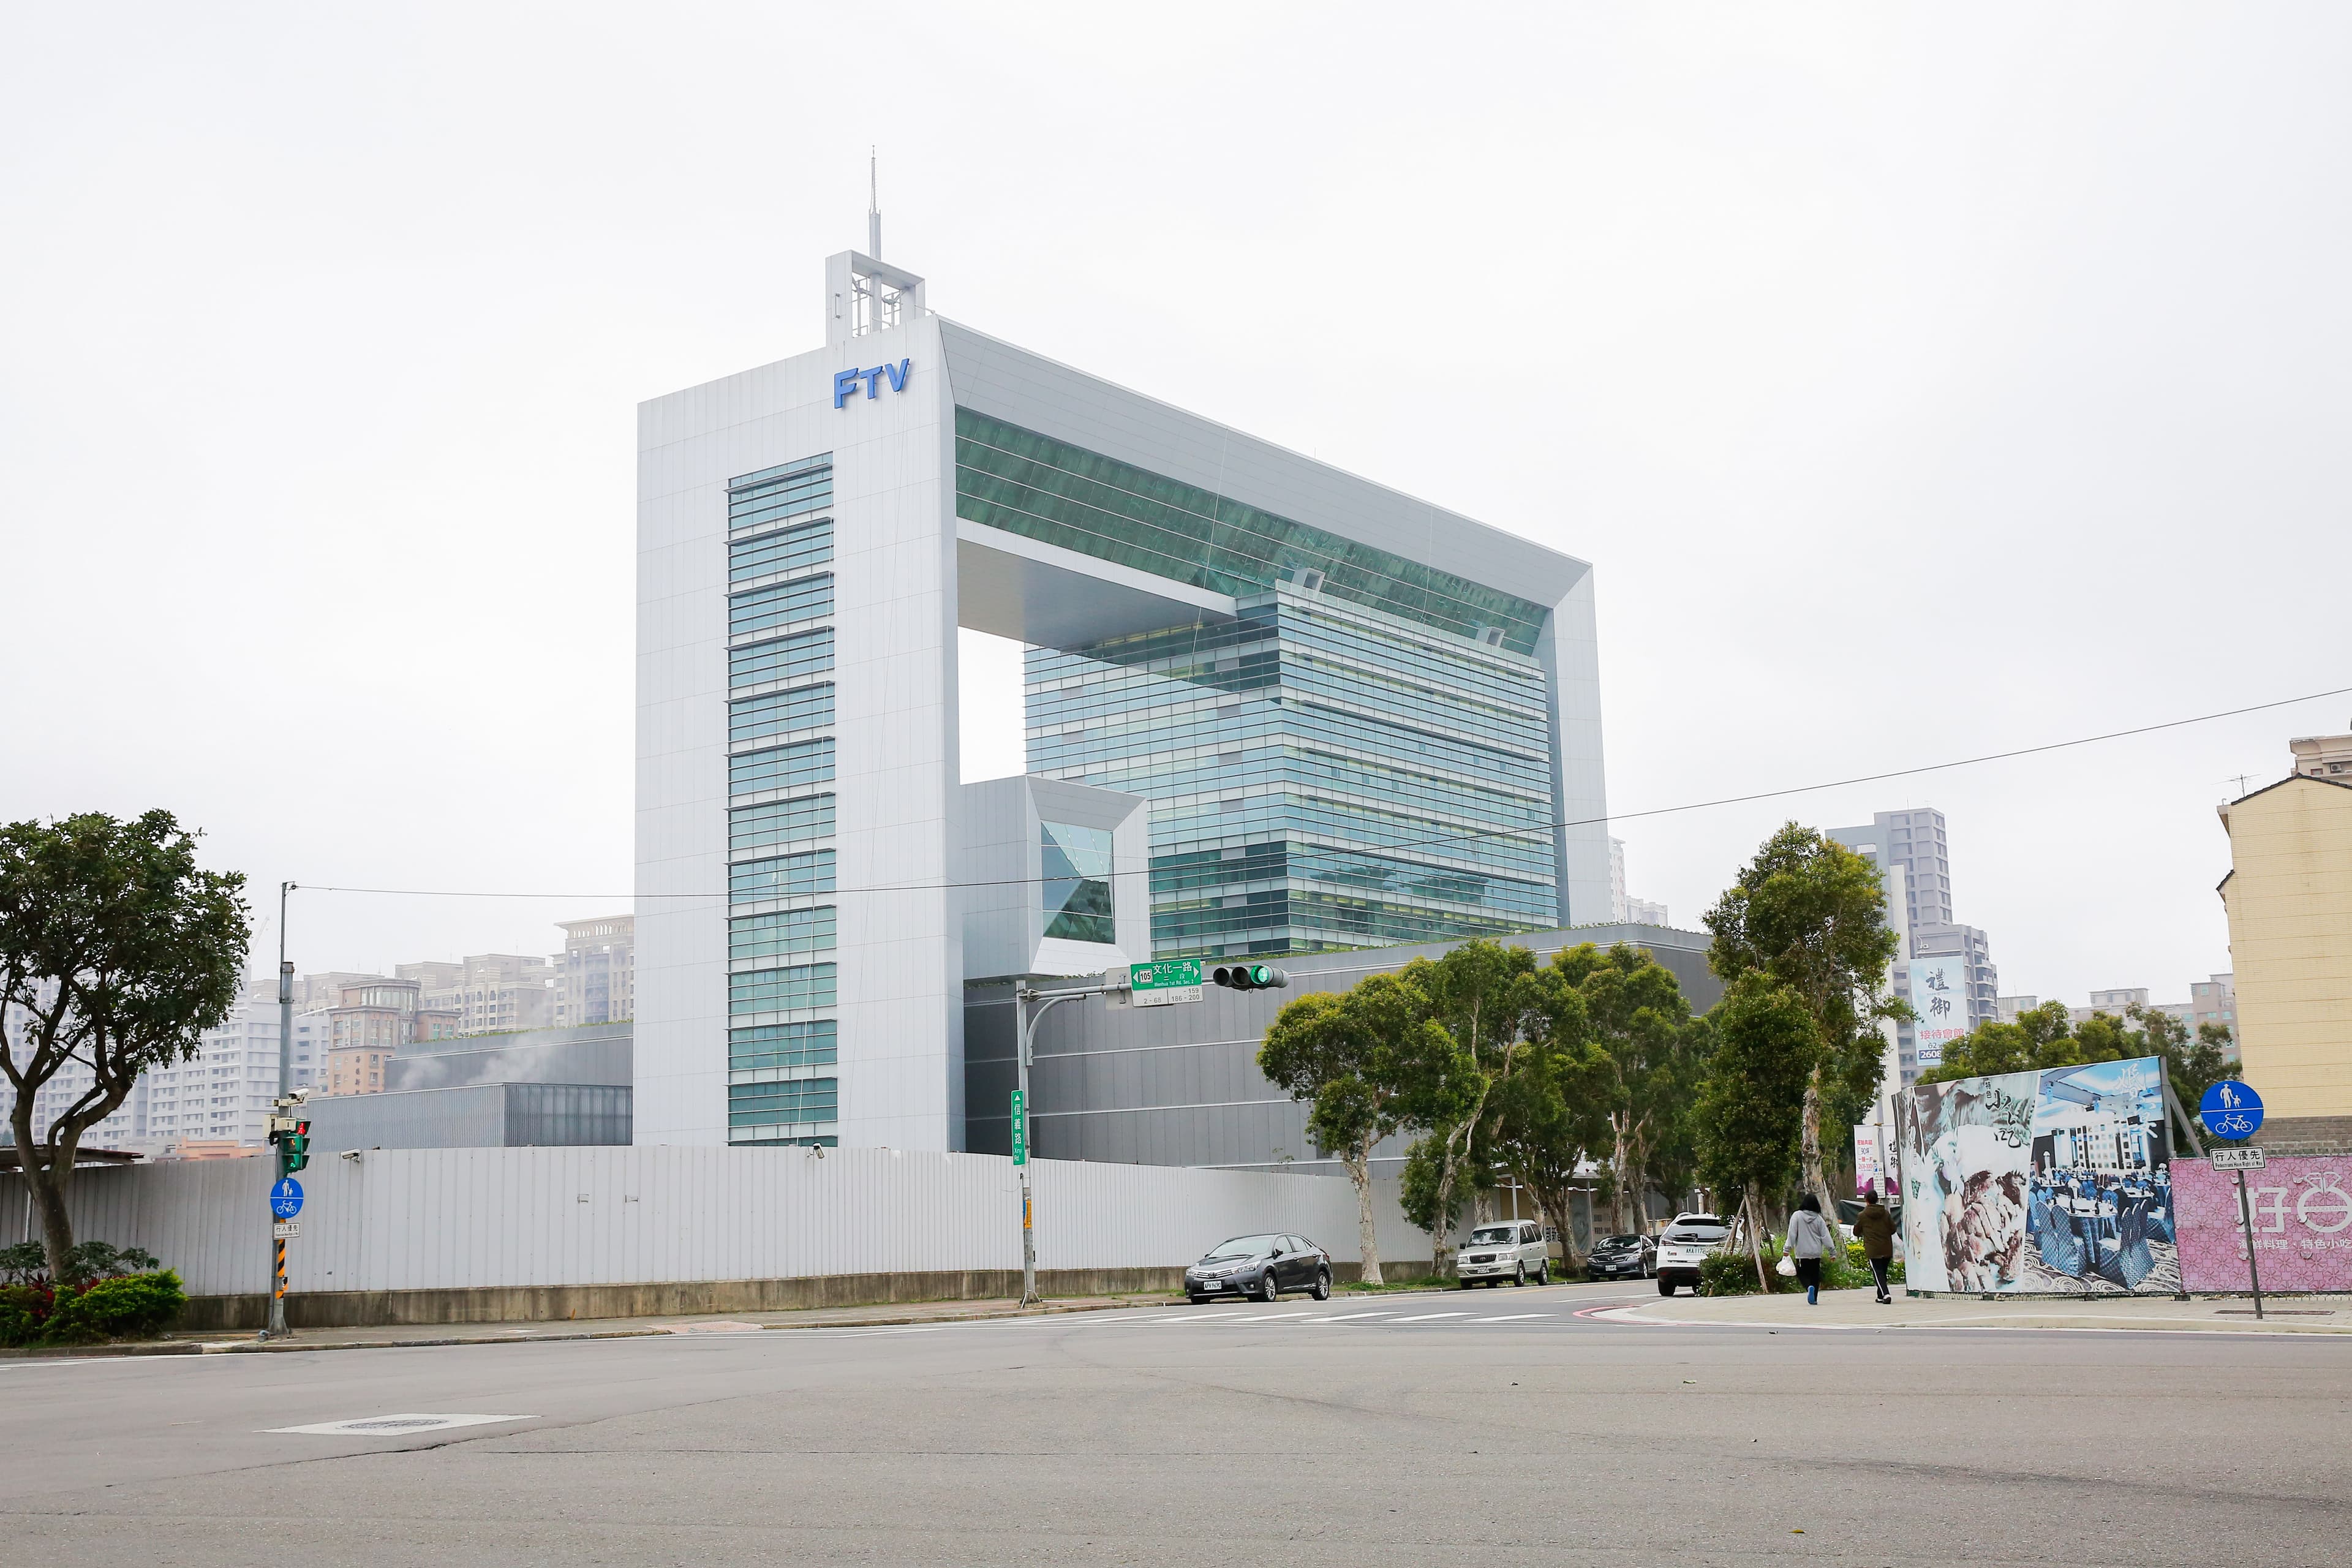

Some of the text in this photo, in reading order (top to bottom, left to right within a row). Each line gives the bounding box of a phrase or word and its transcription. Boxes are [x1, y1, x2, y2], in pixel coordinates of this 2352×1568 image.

[834, 358, 910, 409] FTV
[1152, 962, 1193, 975] 文化一路
[1920, 1028, 1964, 1040] 接待會館
[1920, 1050, 1942, 1059] 2608
[1985, 1081, 1992, 1098] 特色
[2214, 1150, 2260, 1162] 行人優先
